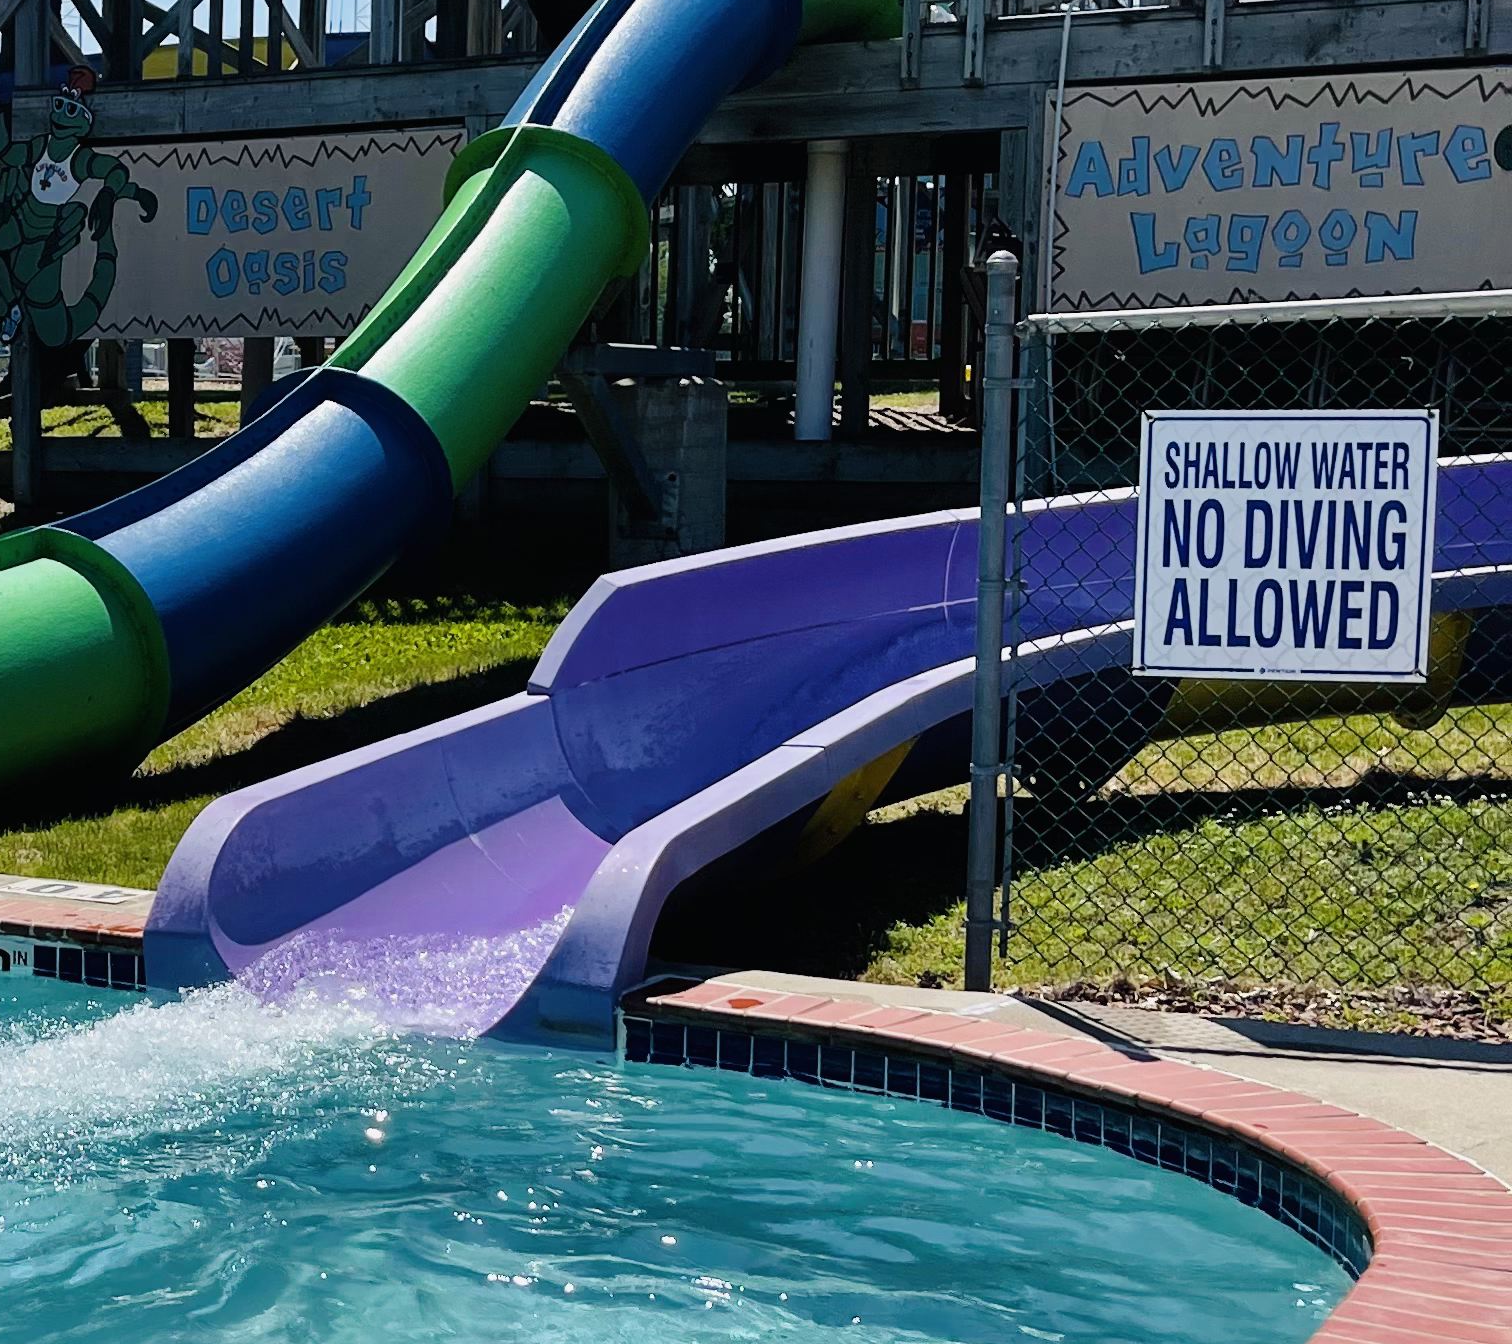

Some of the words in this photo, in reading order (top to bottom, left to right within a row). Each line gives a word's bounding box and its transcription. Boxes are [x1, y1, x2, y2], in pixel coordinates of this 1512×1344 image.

[1064, 122, 1493, 199] Adventure
[186, 175, 372, 235] Desert
[205, 247, 348, 298] Oasis
[1130, 209, 1419, 274] Lagoon
[1164, 441, 1302, 490] SHALLOW
[1311, 441, 1410, 490] WATER
[1162, 498, 1225, 569] NO
[1244, 499, 1407, 571] DIVING
[1163, 577, 1399, 650] ALLOWED
